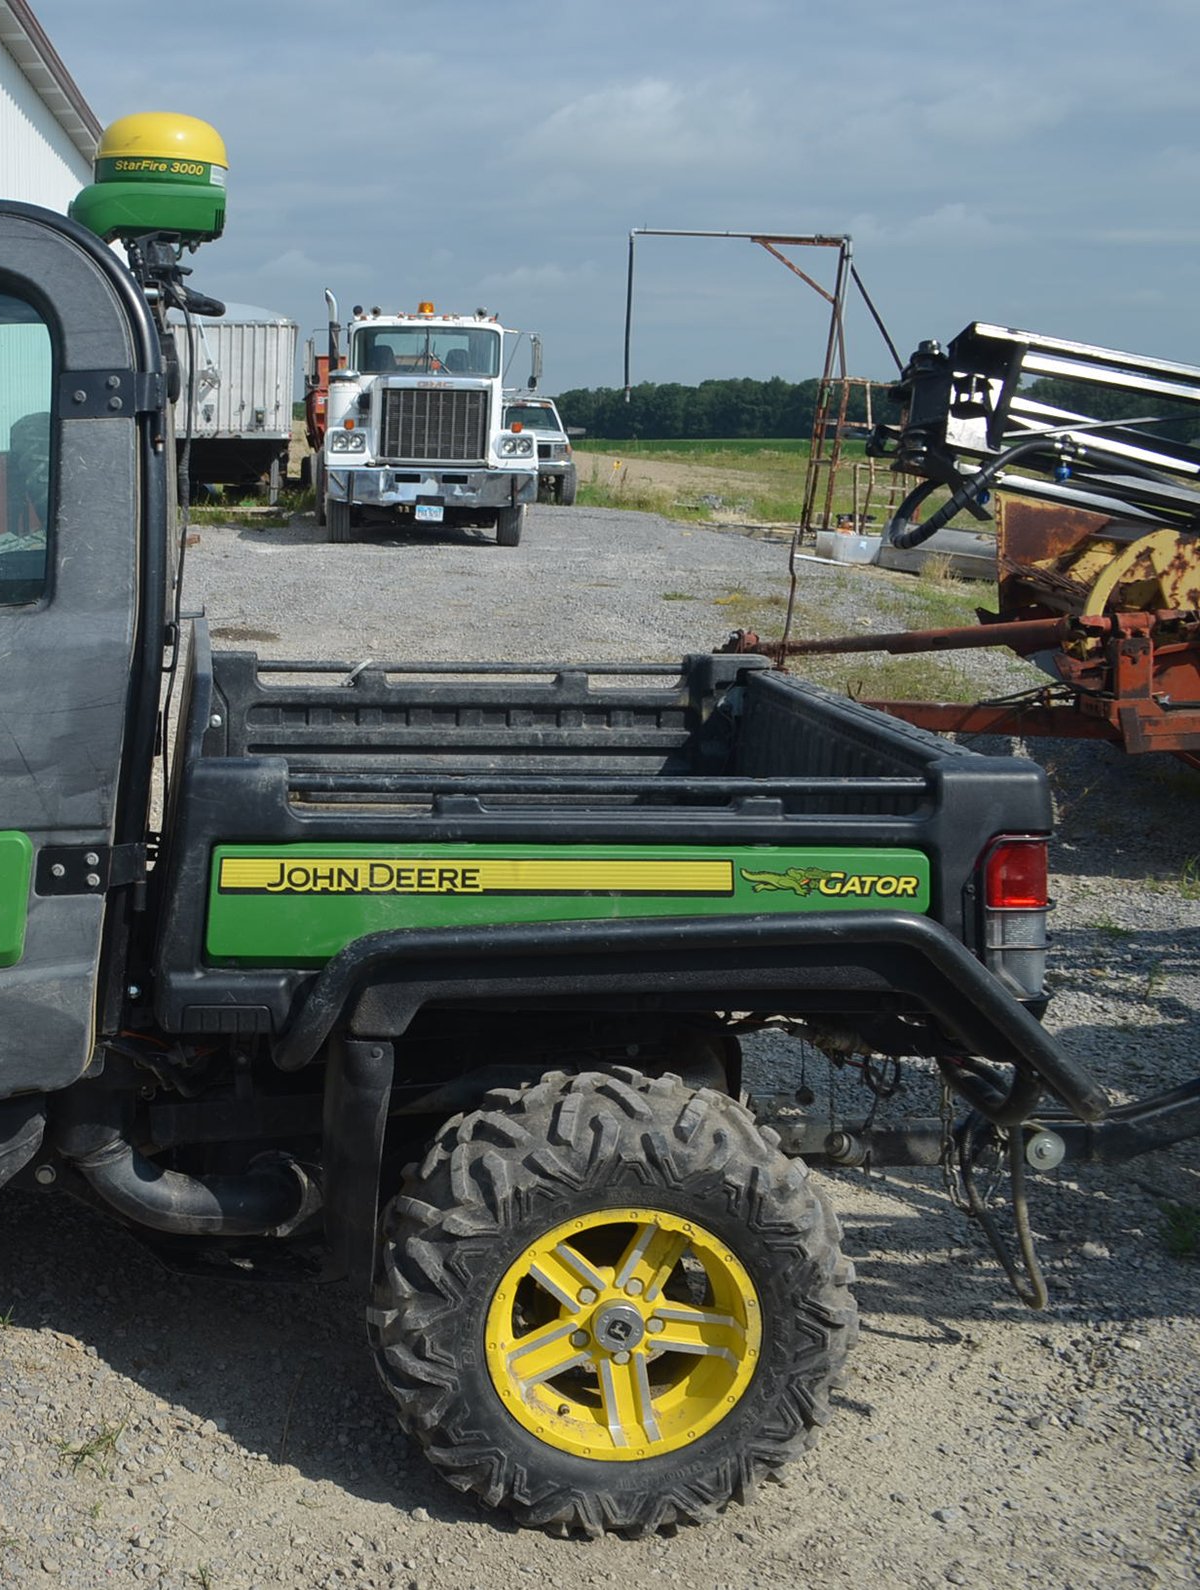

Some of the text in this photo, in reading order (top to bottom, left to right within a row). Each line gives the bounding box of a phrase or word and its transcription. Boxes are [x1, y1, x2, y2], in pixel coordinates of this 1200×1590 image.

[114, 159, 167, 172] StarFire
[171, 161, 204, 176] 3000
[267, 862, 481, 889] JOHN DEERE
[818, 871, 919, 896] GATOR
